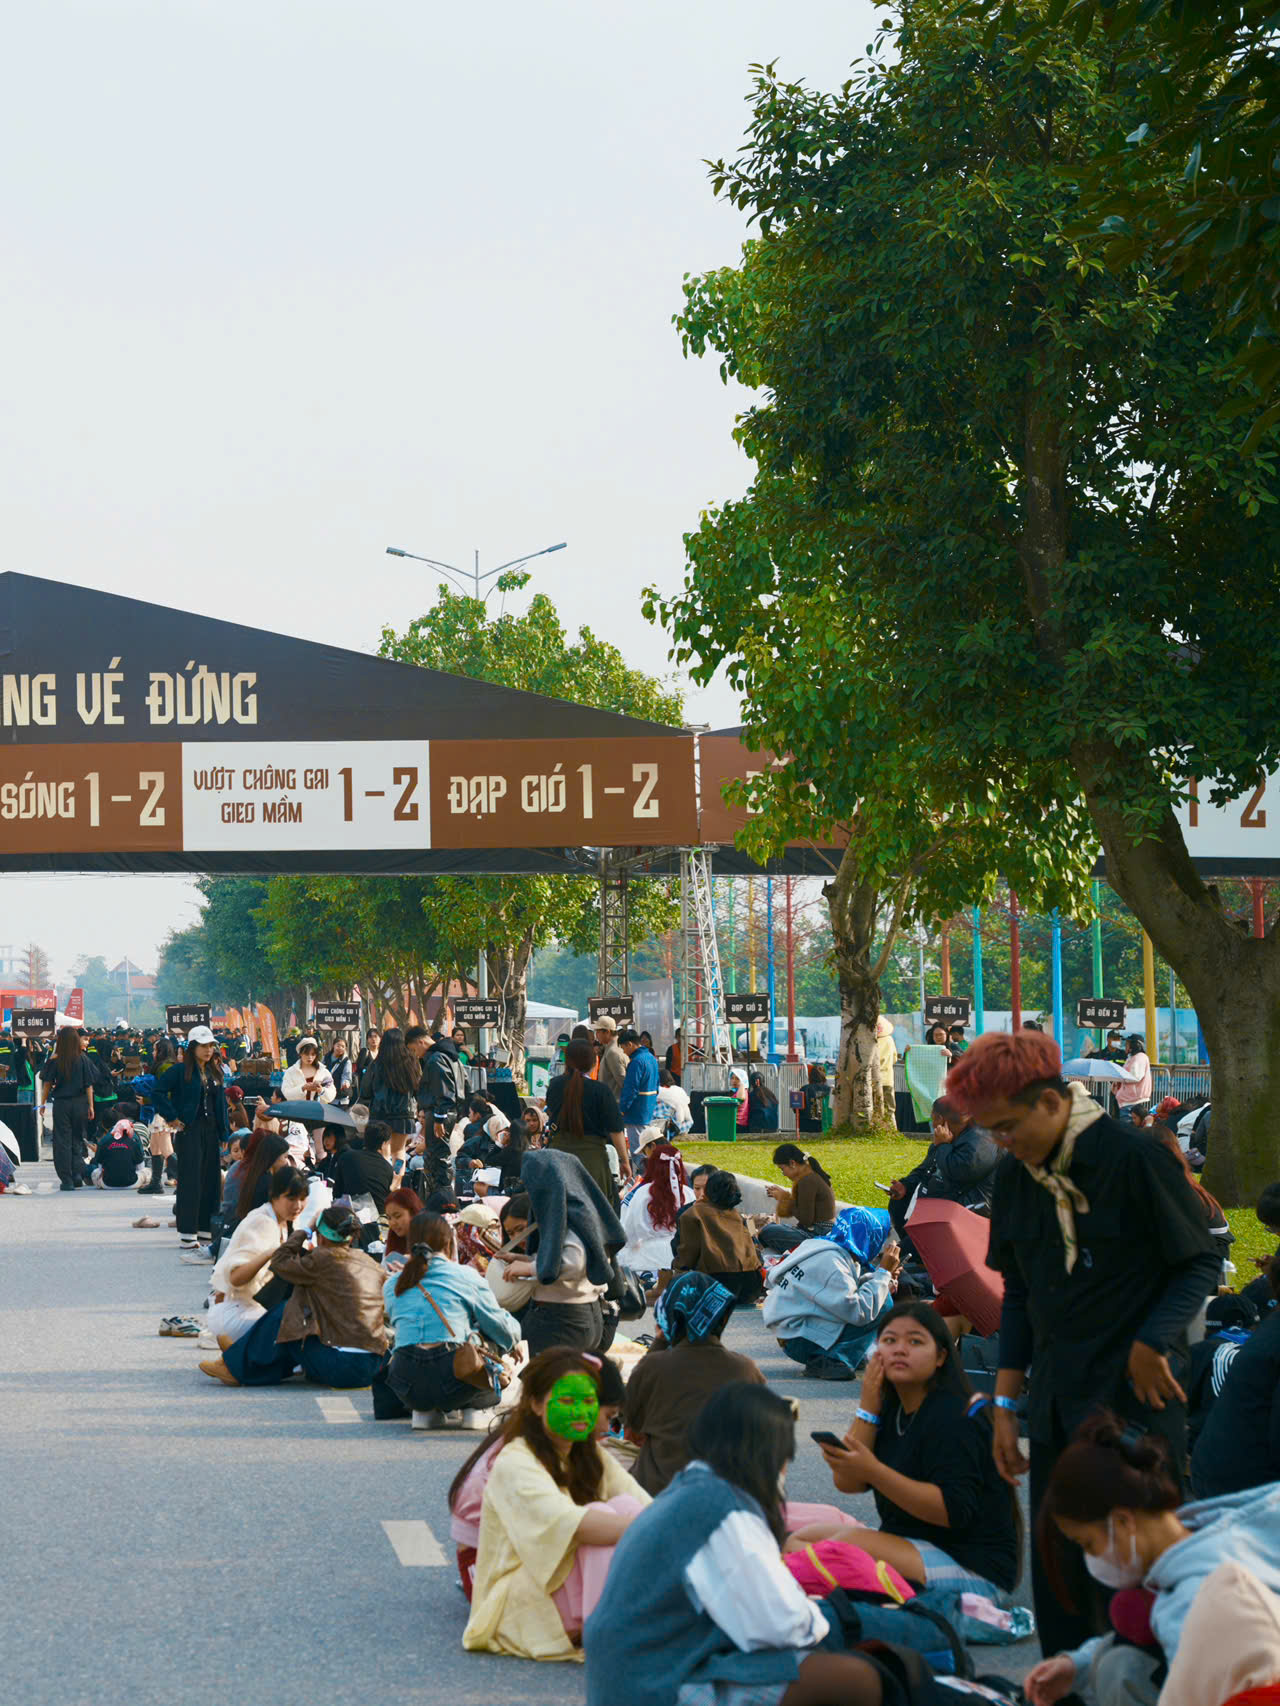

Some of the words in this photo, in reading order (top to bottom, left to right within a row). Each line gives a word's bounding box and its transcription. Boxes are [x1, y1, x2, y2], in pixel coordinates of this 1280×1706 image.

[76, 656, 124, 725] VÉ
[145, 660, 257, 725] ĐỨNG
[1, 771, 75, 819] SÓNG
[194, 766, 235, 794] VƯỢT
[243, 764, 296, 790] CHÔNG
[304, 769, 329, 789] GAI
[447, 775, 507, 819] ĐẠP
[521, 763, 566, 813] GIÓ
[221, 802, 255, 823] GIEO
[263, 794, 302, 823] MẦM
